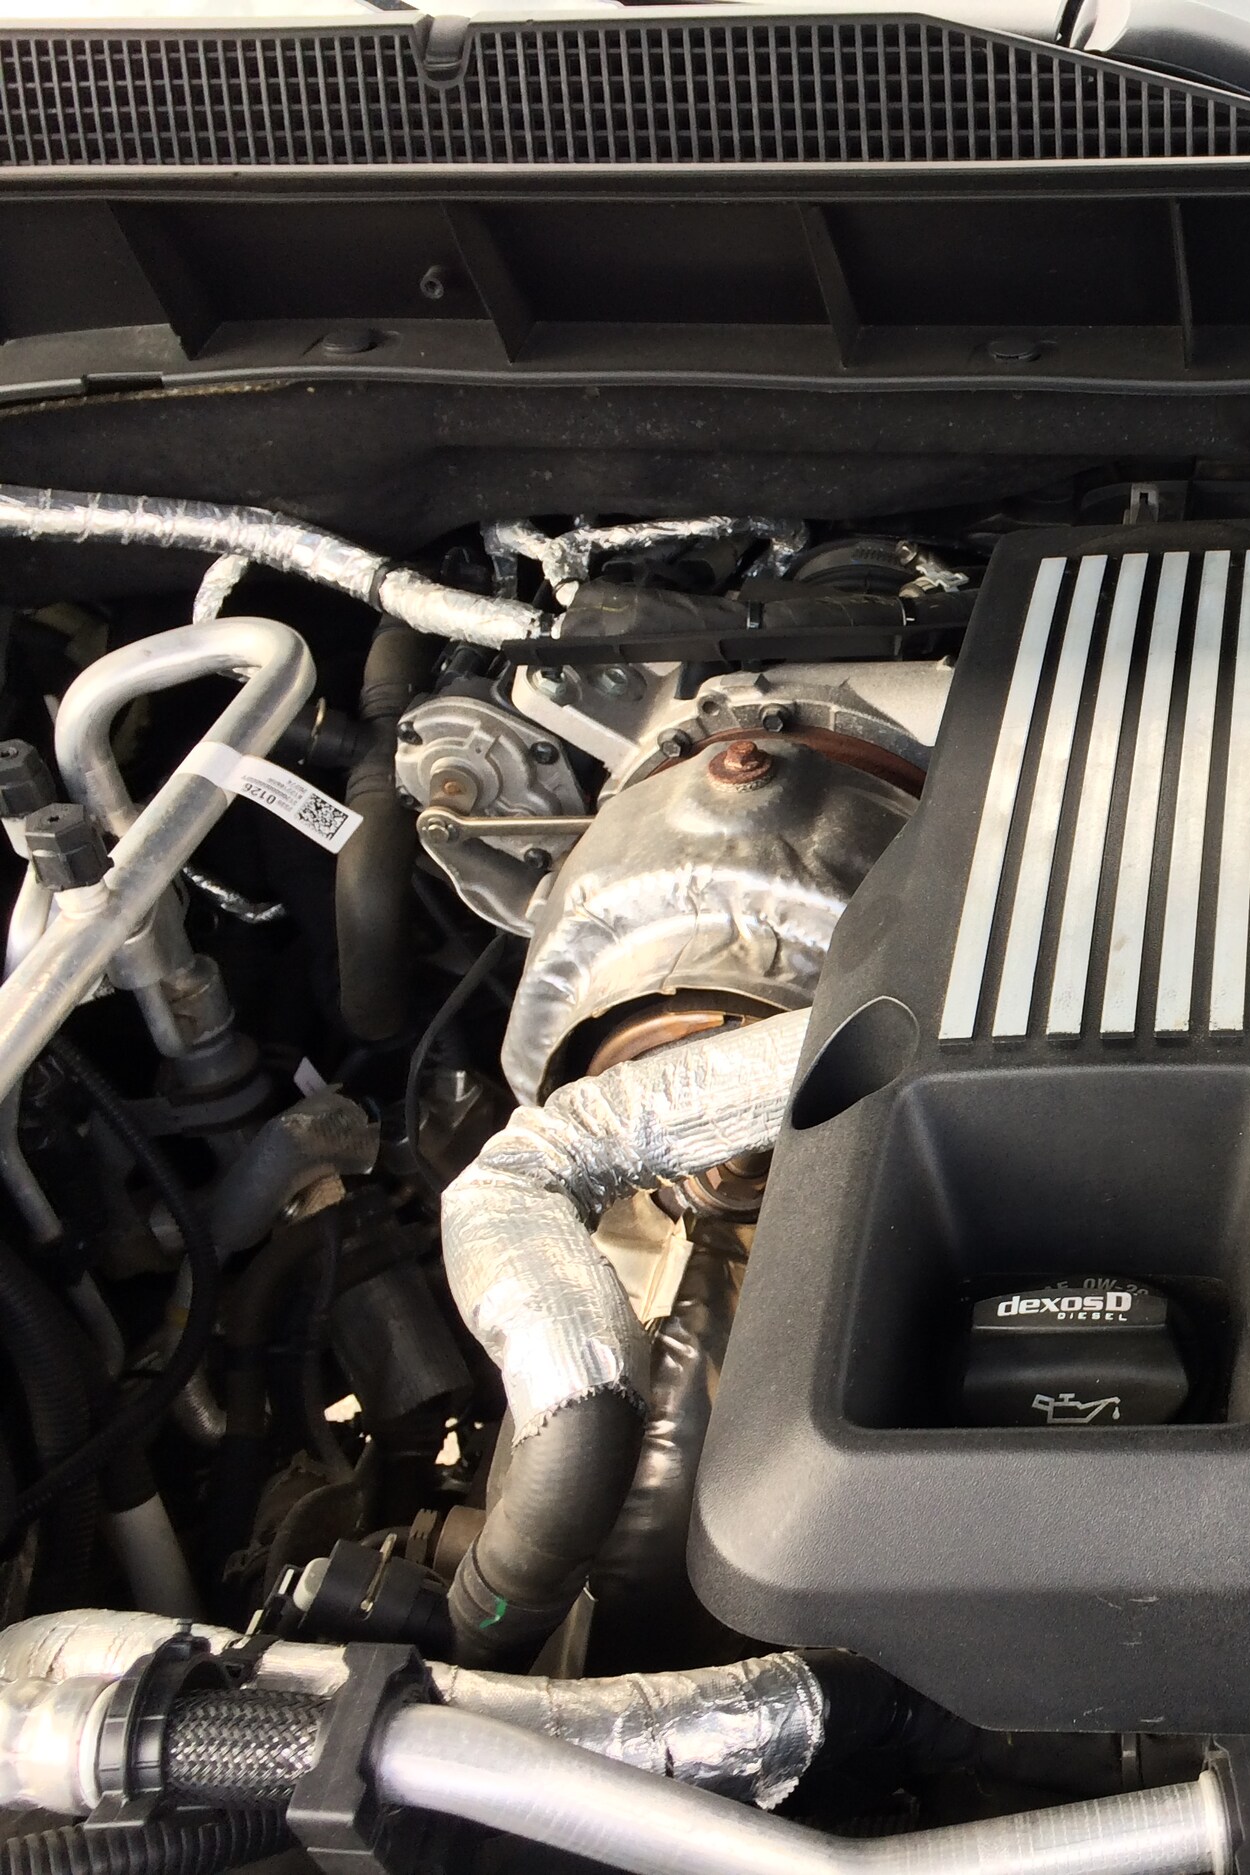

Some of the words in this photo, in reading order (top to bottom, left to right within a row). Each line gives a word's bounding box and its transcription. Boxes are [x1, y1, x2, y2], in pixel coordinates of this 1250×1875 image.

[241, 782, 276, 805] 0126
[997, 1291, 1132, 1317] dexosD
[1057, 1312, 1128, 1322] DIESEL
